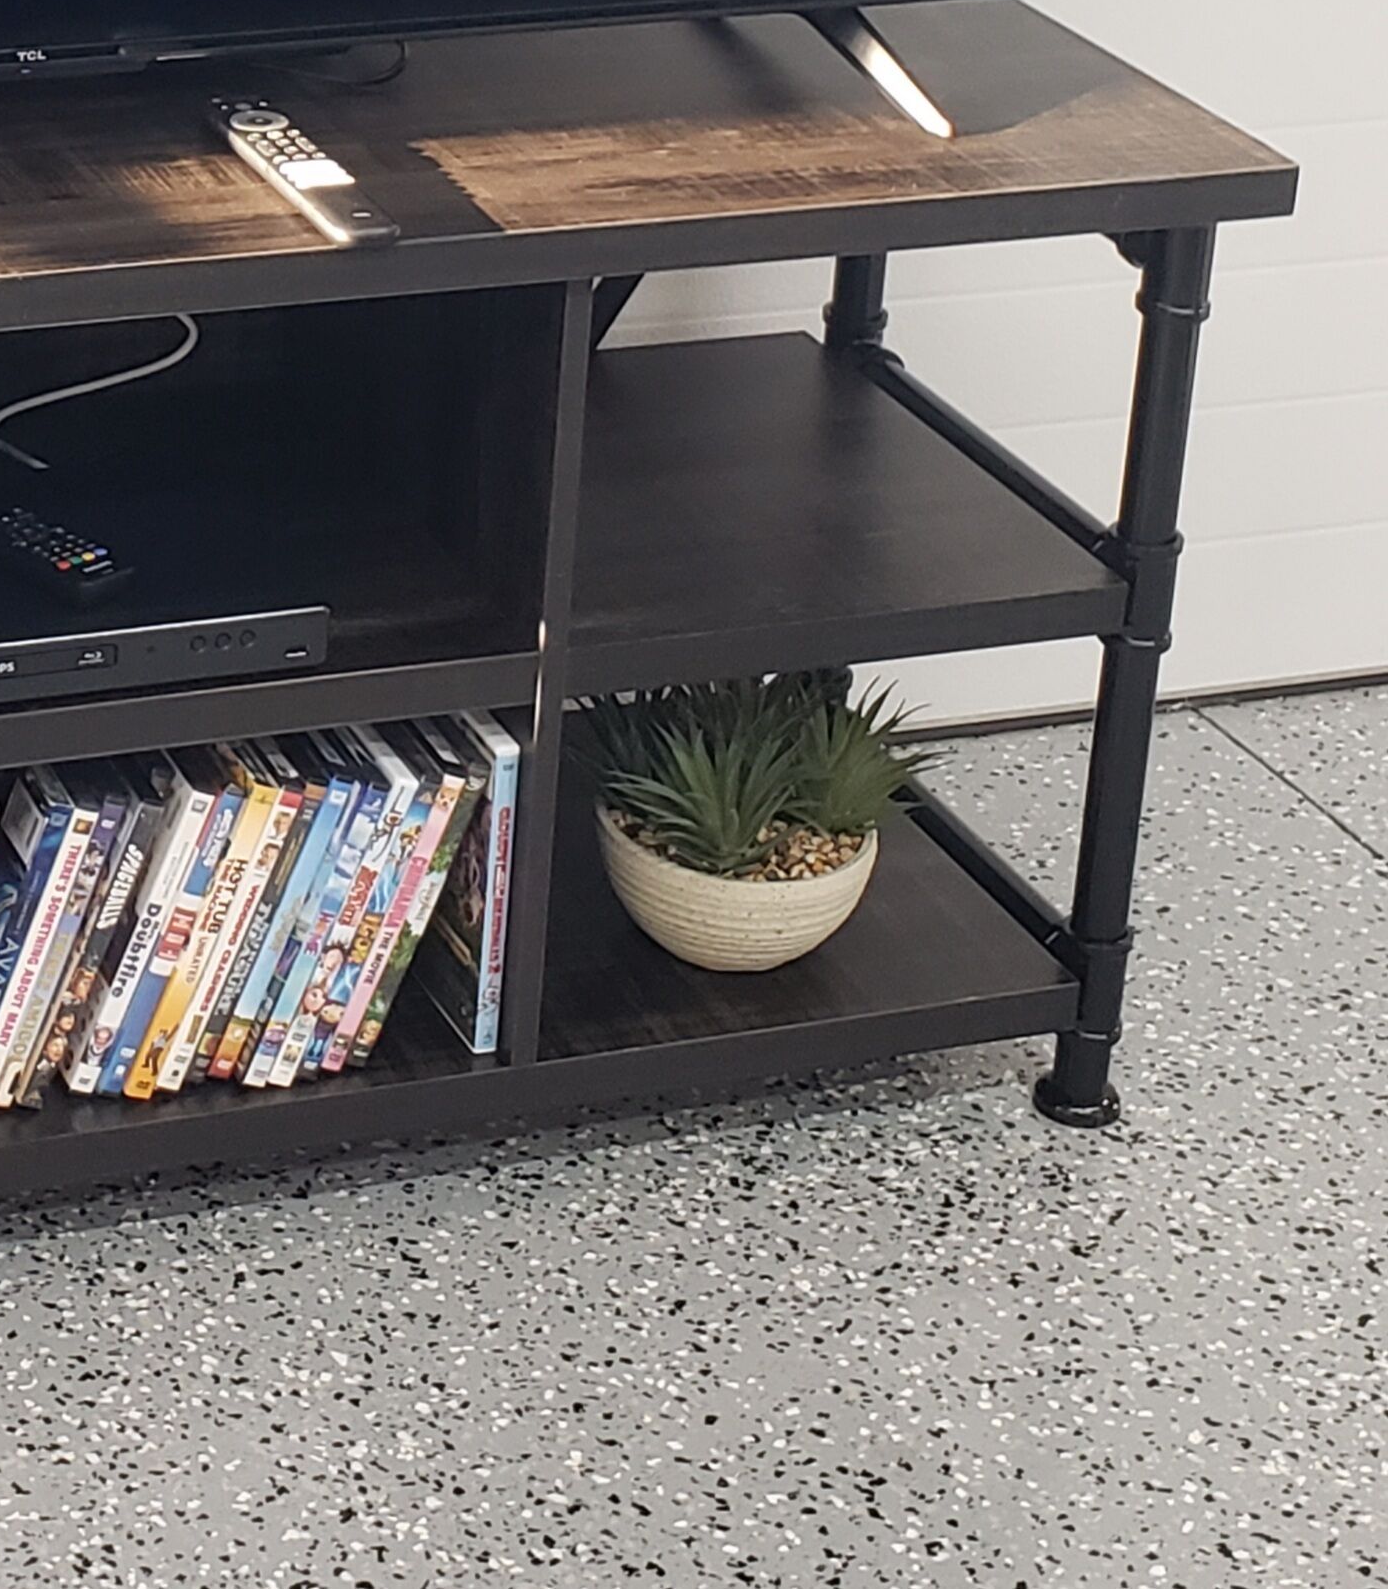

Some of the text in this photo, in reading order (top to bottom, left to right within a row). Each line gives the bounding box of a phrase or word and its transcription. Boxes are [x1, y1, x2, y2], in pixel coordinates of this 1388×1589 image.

[17, 50, 47, 61] TCL
[54, 845, 82, 891] THERE'S
[96, 844, 144, 930] SPACEBALLS
[208, 859, 248, 934] HOT TUB
[27, 895, 63, 966] SOMETHING
[112, 903, 162, 998] Doubtfire
[200, 885, 260, 1011] WEDDING CRASHERS
[379, 931, 393, 951] THE
[186, 936, 209, 983] UNRATED
[364, 953, 384, 984] MOVIE
[11, 969, 35, 1009] ABOUT
